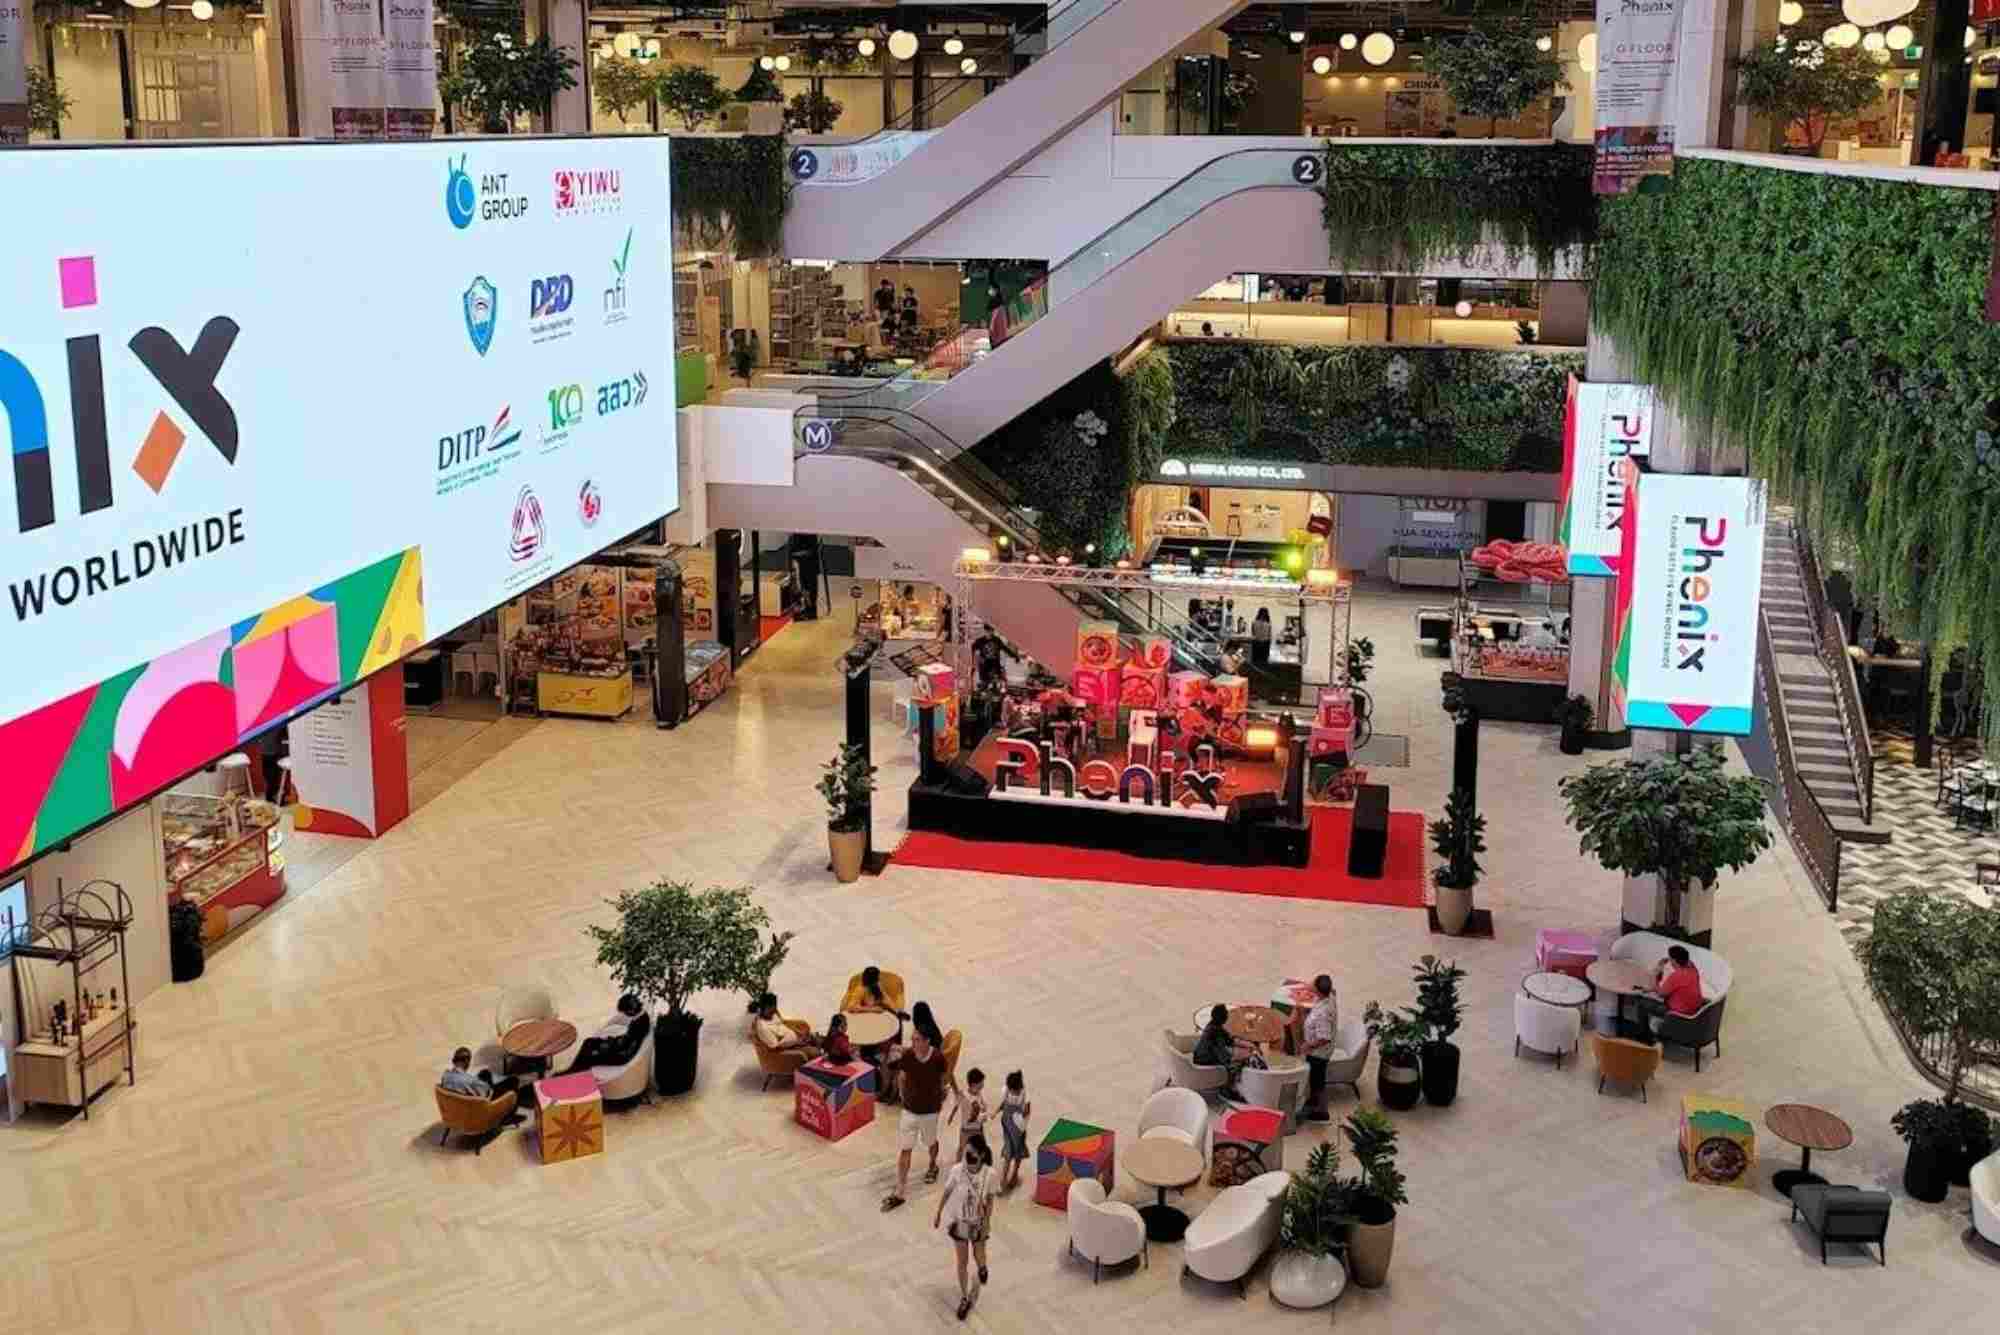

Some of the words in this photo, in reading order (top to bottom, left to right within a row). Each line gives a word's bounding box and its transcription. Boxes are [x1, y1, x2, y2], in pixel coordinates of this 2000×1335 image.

[577, 170, 621, 195] YIWU
[1300, 160, 1314, 180] 2
[482, 174, 508, 195] ANT
[482, 197, 529, 220] GROUP
[438, 424, 487, 470] DITP
[806, 426, 826, 446] M
[8, 507, 245, 622] WORLDWIDE
[1676, 515, 1727, 673] Phenix
[994, 737, 1225, 809] Phenix
